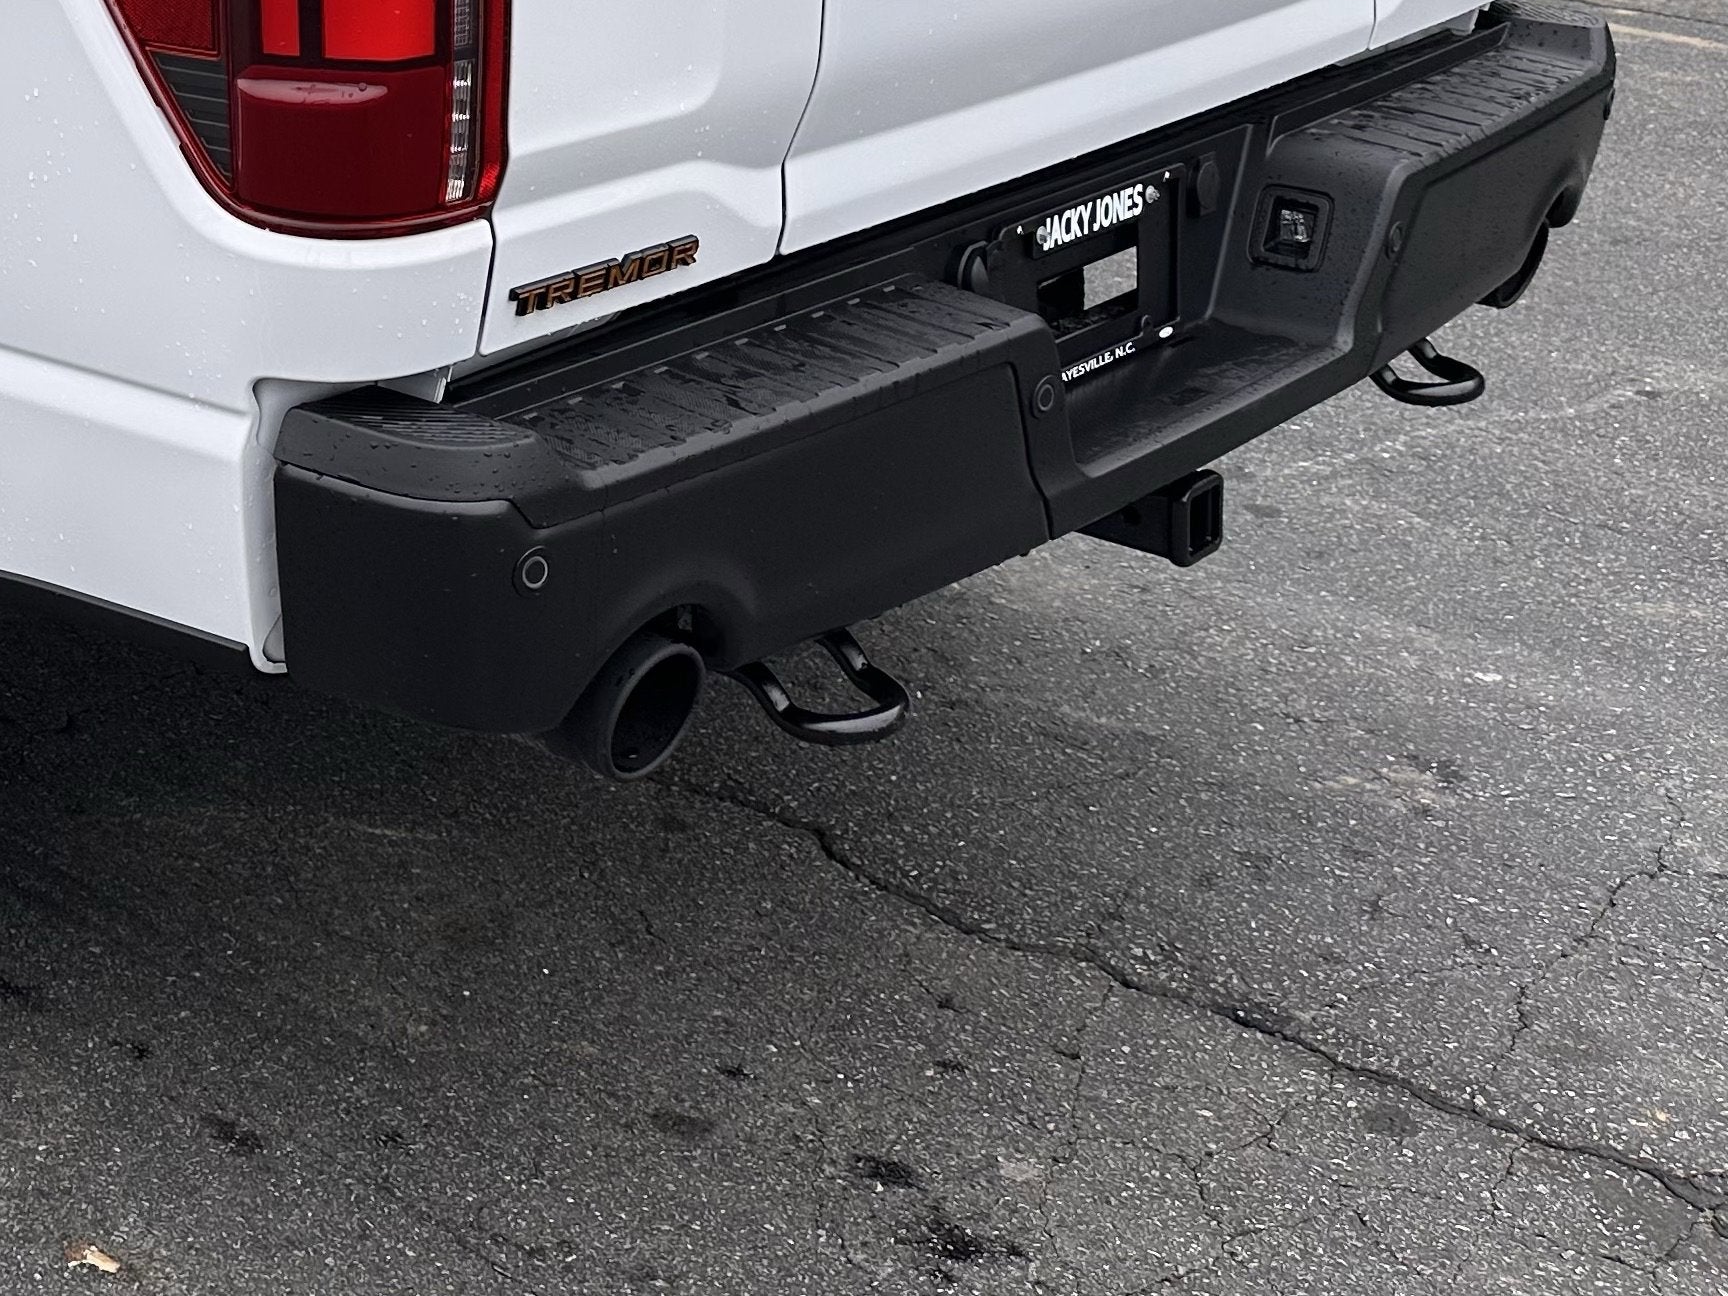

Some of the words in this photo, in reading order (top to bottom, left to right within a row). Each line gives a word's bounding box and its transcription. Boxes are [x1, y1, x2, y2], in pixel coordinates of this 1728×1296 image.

[1043, 201, 1093, 251] JACKY
[1092, 184, 1144, 232] JONES
[508, 234, 700, 316] TREMOR
[1115, 341, 1136, 359] N.C.
